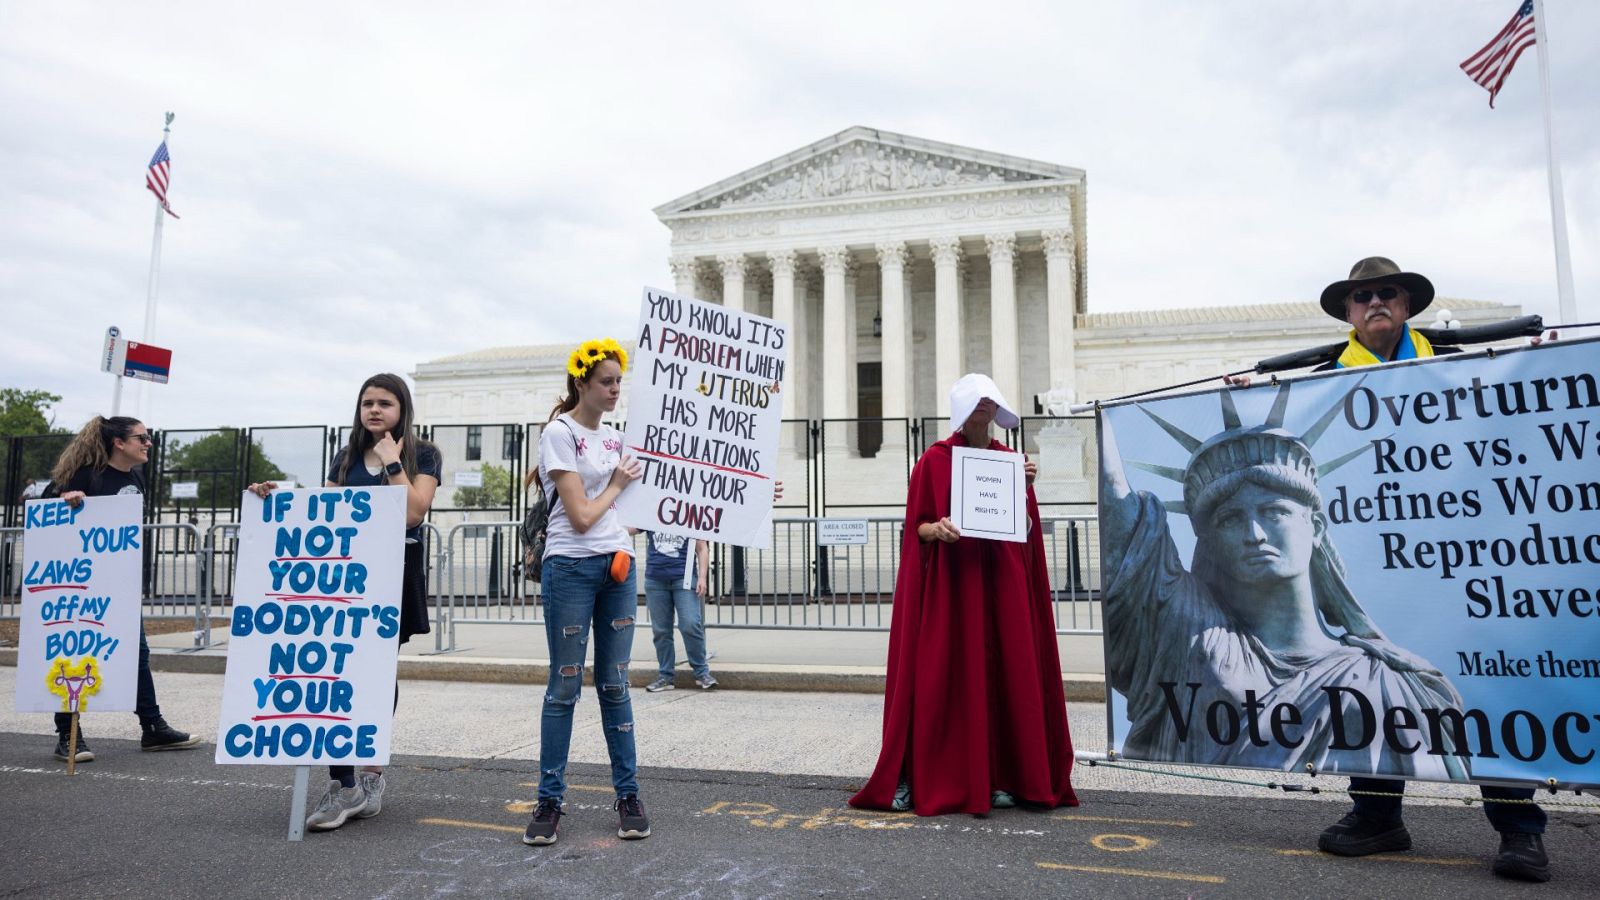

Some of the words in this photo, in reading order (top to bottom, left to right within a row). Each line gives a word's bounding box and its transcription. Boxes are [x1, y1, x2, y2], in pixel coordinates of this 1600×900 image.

[648, 292, 682, 324] YOU
[688, 303, 742, 340] KNOW
[747, 319, 785, 349] IT'S
[639, 324, 652, 351] A
[658, 327, 742, 371] PROBLEM
[745, 351, 785, 382] WHEN
[652, 358, 688, 390] MY
[699, 371, 770, 409] UTERUS
[660, 393, 698, 427] HAS
[707, 405, 758, 440] MORE
[1343, 372, 1600, 431] Overturn
[643, 424, 761, 473] REGULATIONS
[1370, 438, 1453, 475] Roe
[1464, 437, 1527, 467] vs.
[1538, 420, 1600, 461] W
[637, 456, 695, 495] THAN
[700, 470, 747, 505] YOUR
[975, 475, 1002, 484] WOMEN
[979, 491, 998, 499] HAVE
[26, 500, 84, 529] KEEP
[263, 492, 294, 523] IF
[308, 489, 372, 523] IT'S
[657, 496, 724, 534] GUNS!
[975, 506, 999, 515] RIGHTS
[1328, 481, 1482, 525] defines
[79, 525, 139, 553] YOUR
[275, 525, 358, 557] NOT
[24, 558, 92, 585] LAWS
[268, 560, 368, 595] YOUR
[1466, 576, 1600, 618] Slave
[45, 629, 119, 661] BODY!
[269, 641, 354, 674] NOT
[1456, 650, 1531, 678] Make
[253, 678, 354, 713] YOUR
[1158, 681, 1305, 749] Vote
[1321, 686, 1600, 765] Democ
[225, 723, 378, 759] CHOICE
